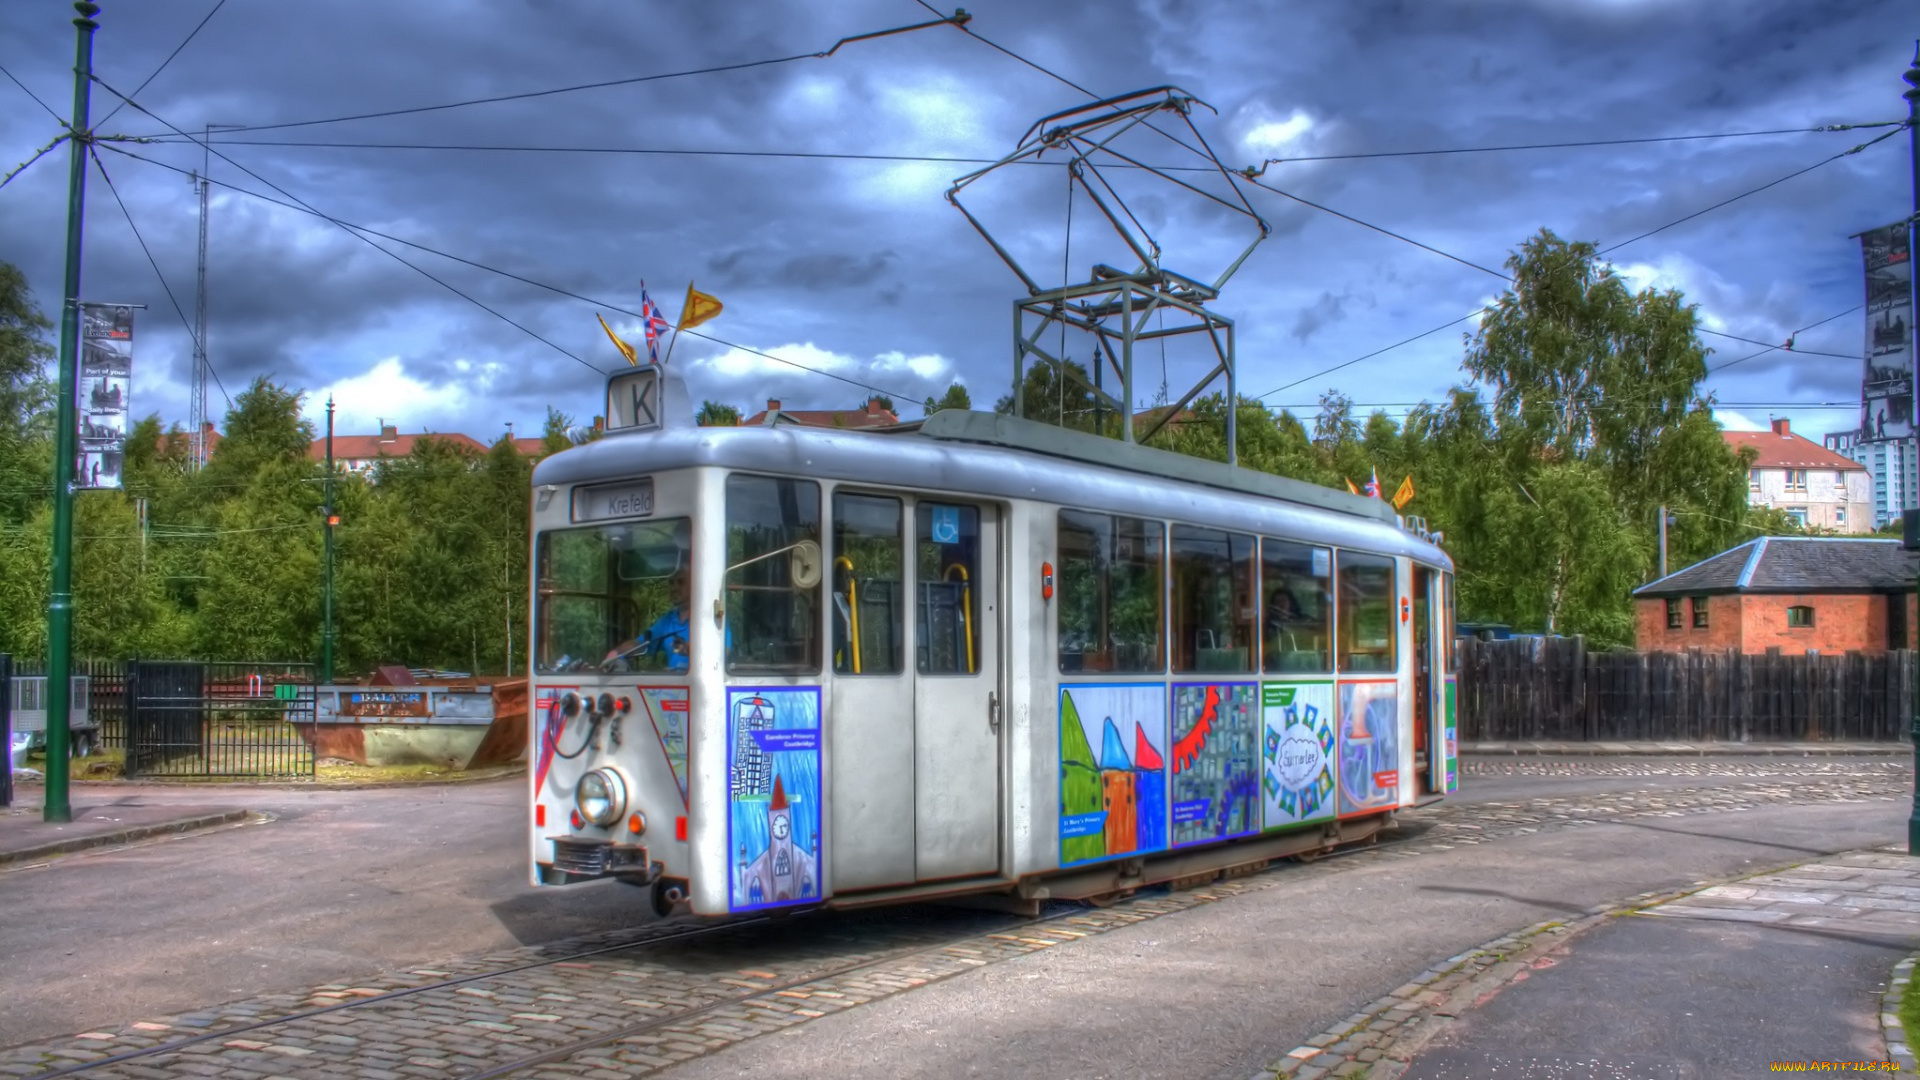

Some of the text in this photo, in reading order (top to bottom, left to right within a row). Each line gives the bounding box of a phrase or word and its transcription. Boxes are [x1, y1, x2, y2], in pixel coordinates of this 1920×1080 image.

[88, 406, 103, 414] daily
[632, 380, 656, 426] K
[608, 492, 653, 515] Krefeld
